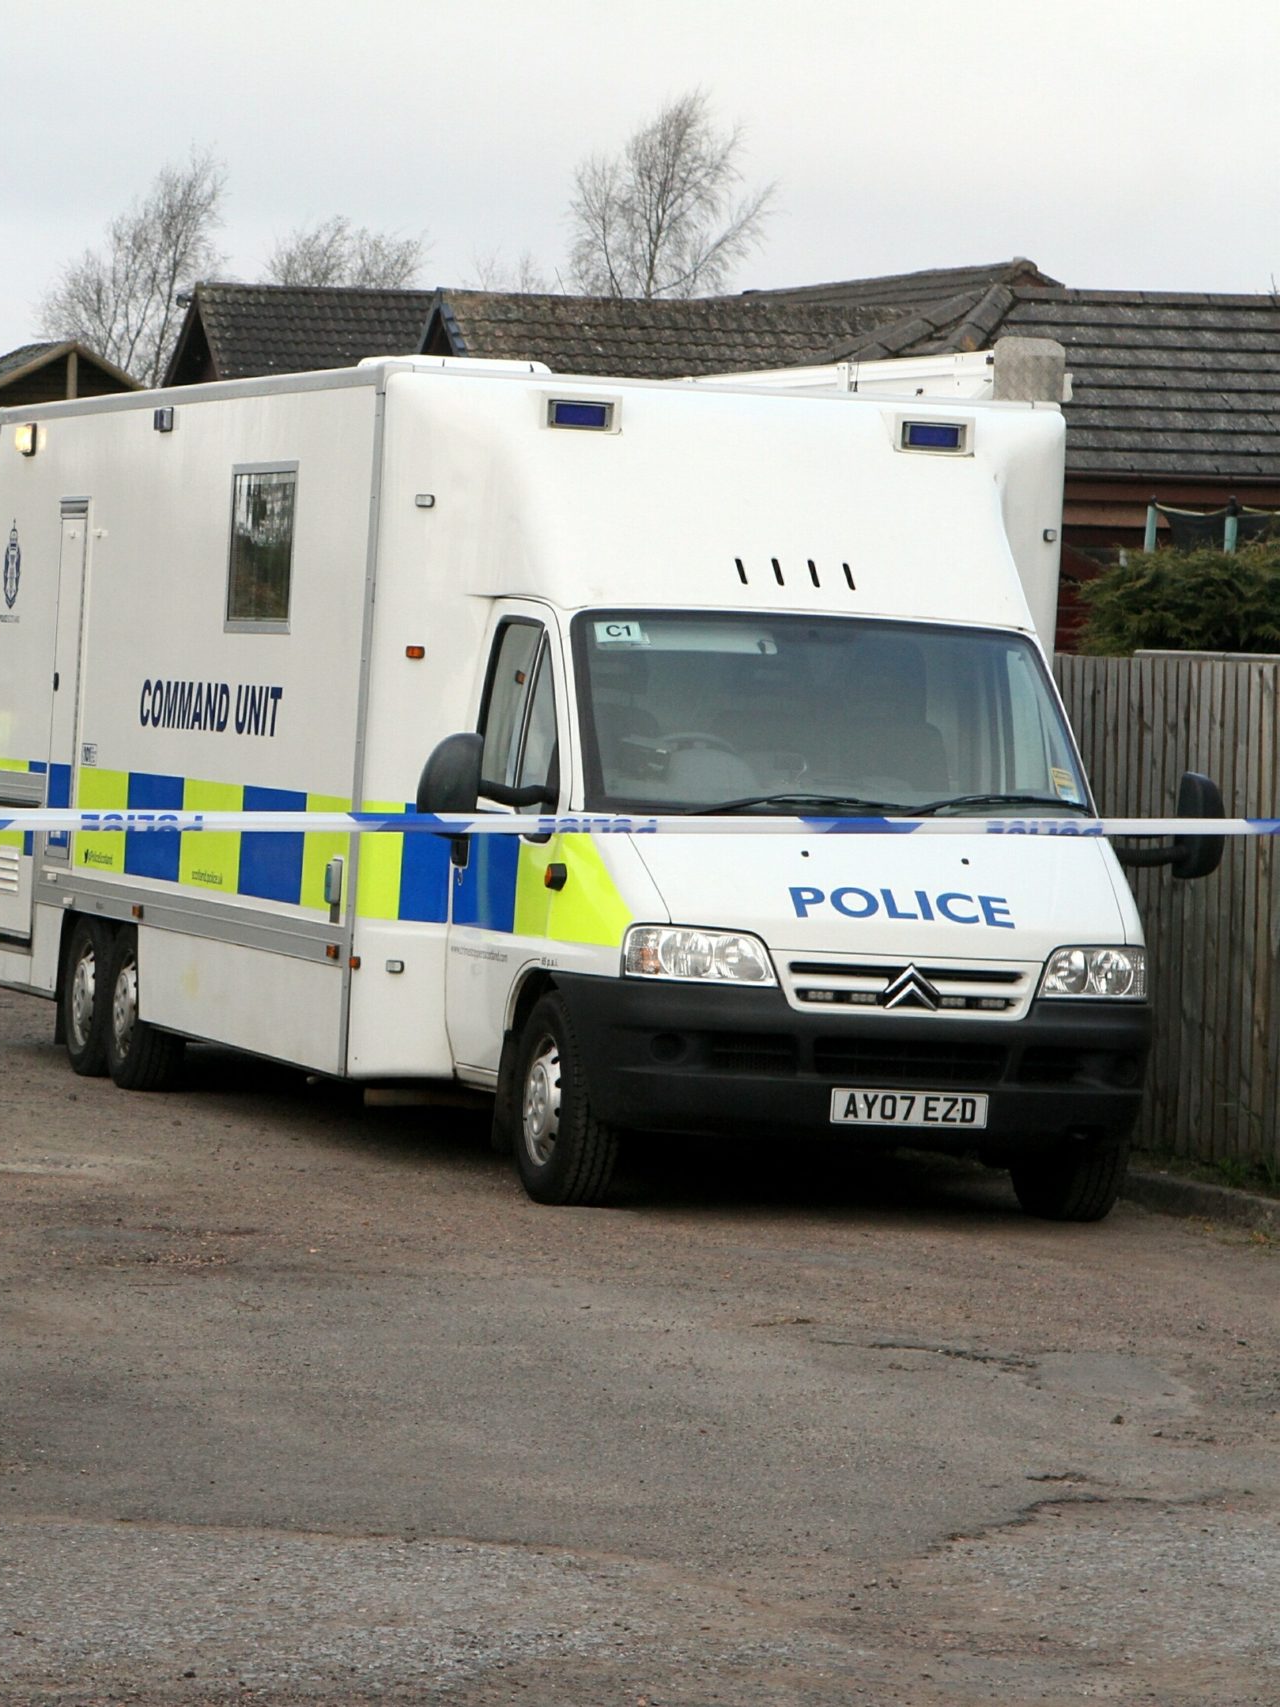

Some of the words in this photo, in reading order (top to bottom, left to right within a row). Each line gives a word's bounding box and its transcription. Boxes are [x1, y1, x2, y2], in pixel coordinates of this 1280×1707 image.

[606, 624, 631, 637] C1
[140, 679, 230, 733] COMMAND
[235, 684, 283, 736] UNIT
[788, 886, 1016, 929] POLICE
[843, 1092, 916, 1122] AY07
[923, 1096, 977, 1124] EZD
